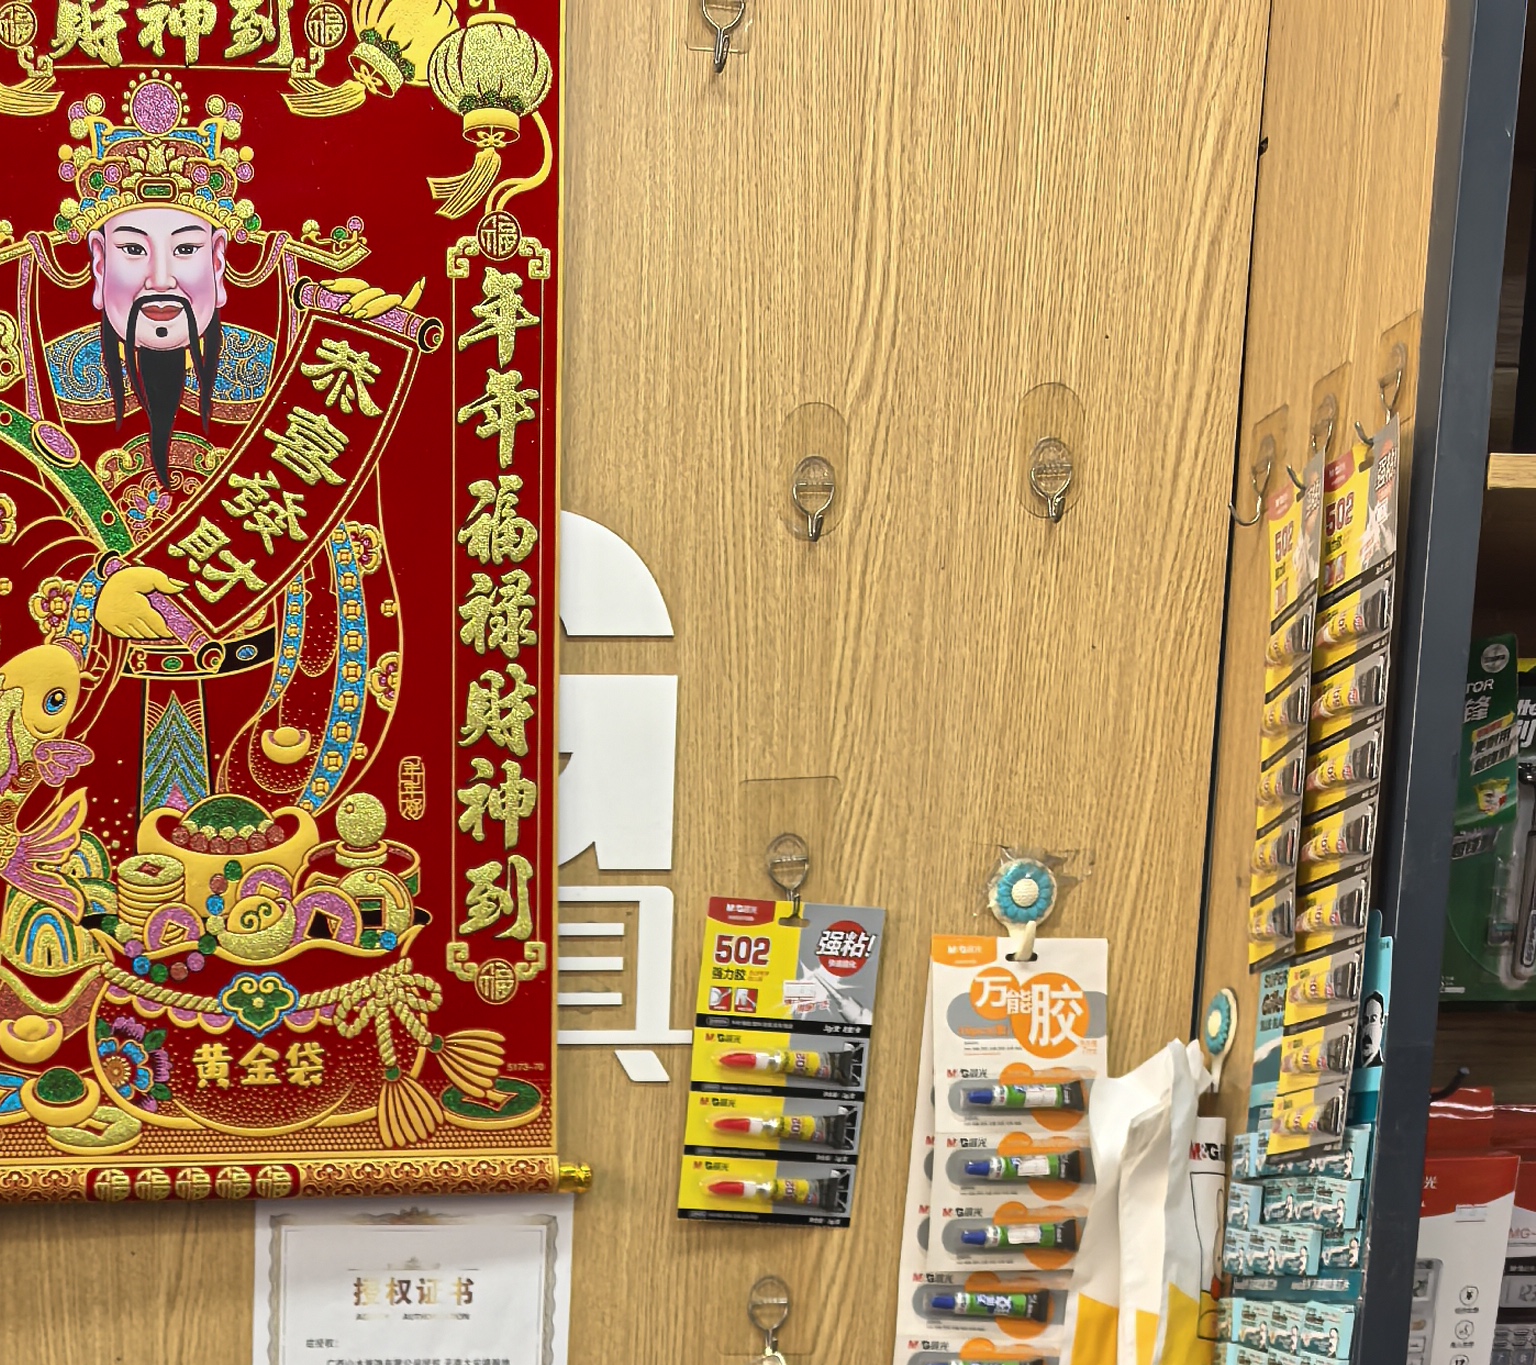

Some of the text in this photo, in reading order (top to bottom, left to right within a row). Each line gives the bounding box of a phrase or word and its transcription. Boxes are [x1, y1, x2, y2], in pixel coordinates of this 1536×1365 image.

[714, 934, 771, 967] 502
[711, 966, 747, 982] 强力胶
[974, 975, 1085, 1048] 万能胶
[193, 1043, 326, 1089] 黄金袋
[352, 1276, 475, 1307] 授权证书
